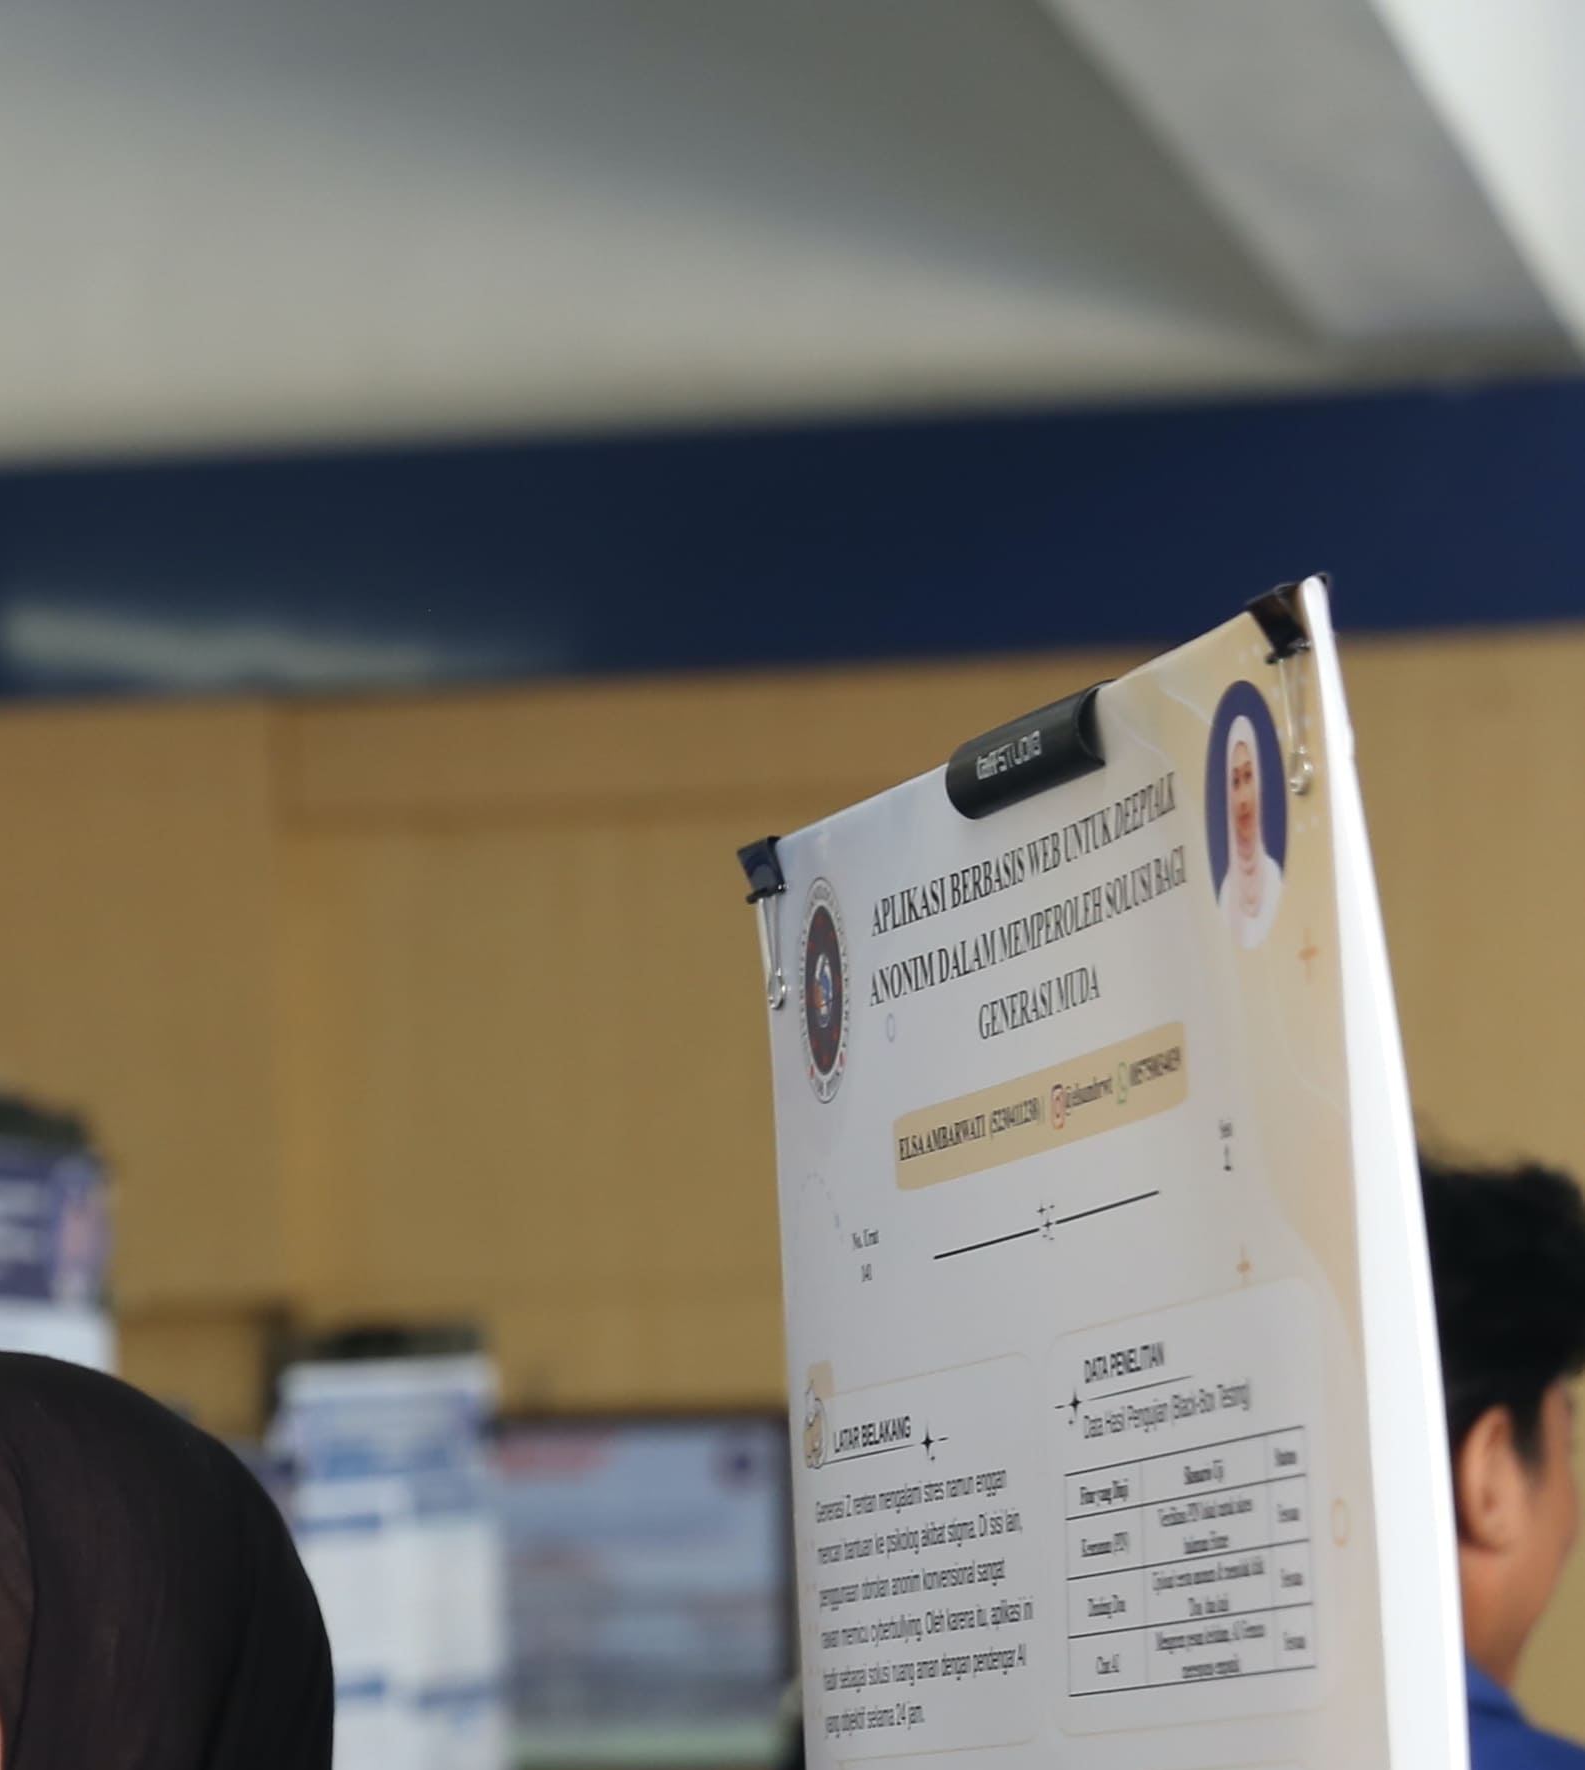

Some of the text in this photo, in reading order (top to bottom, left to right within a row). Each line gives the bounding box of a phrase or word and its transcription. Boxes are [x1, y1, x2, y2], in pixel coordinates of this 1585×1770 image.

[872, 771, 1176, 935] APLIKASI BERBASIS WEB UNTUK DEEPTALK
[871, 843, 1187, 1005] ANONIM DALAM MEMPEROLEH SOLUSI BAGI
[978, 962, 1100, 1041] GENERASI MUDA
[899, 1132, 925, 1161] ELSA
[926, 1113, 986, 1153] AMBARWATI
[1084, 1340, 1164, 1383] DATA PENELITIAN
[834, 1415, 911, 1453] LATAR BELAKANG
